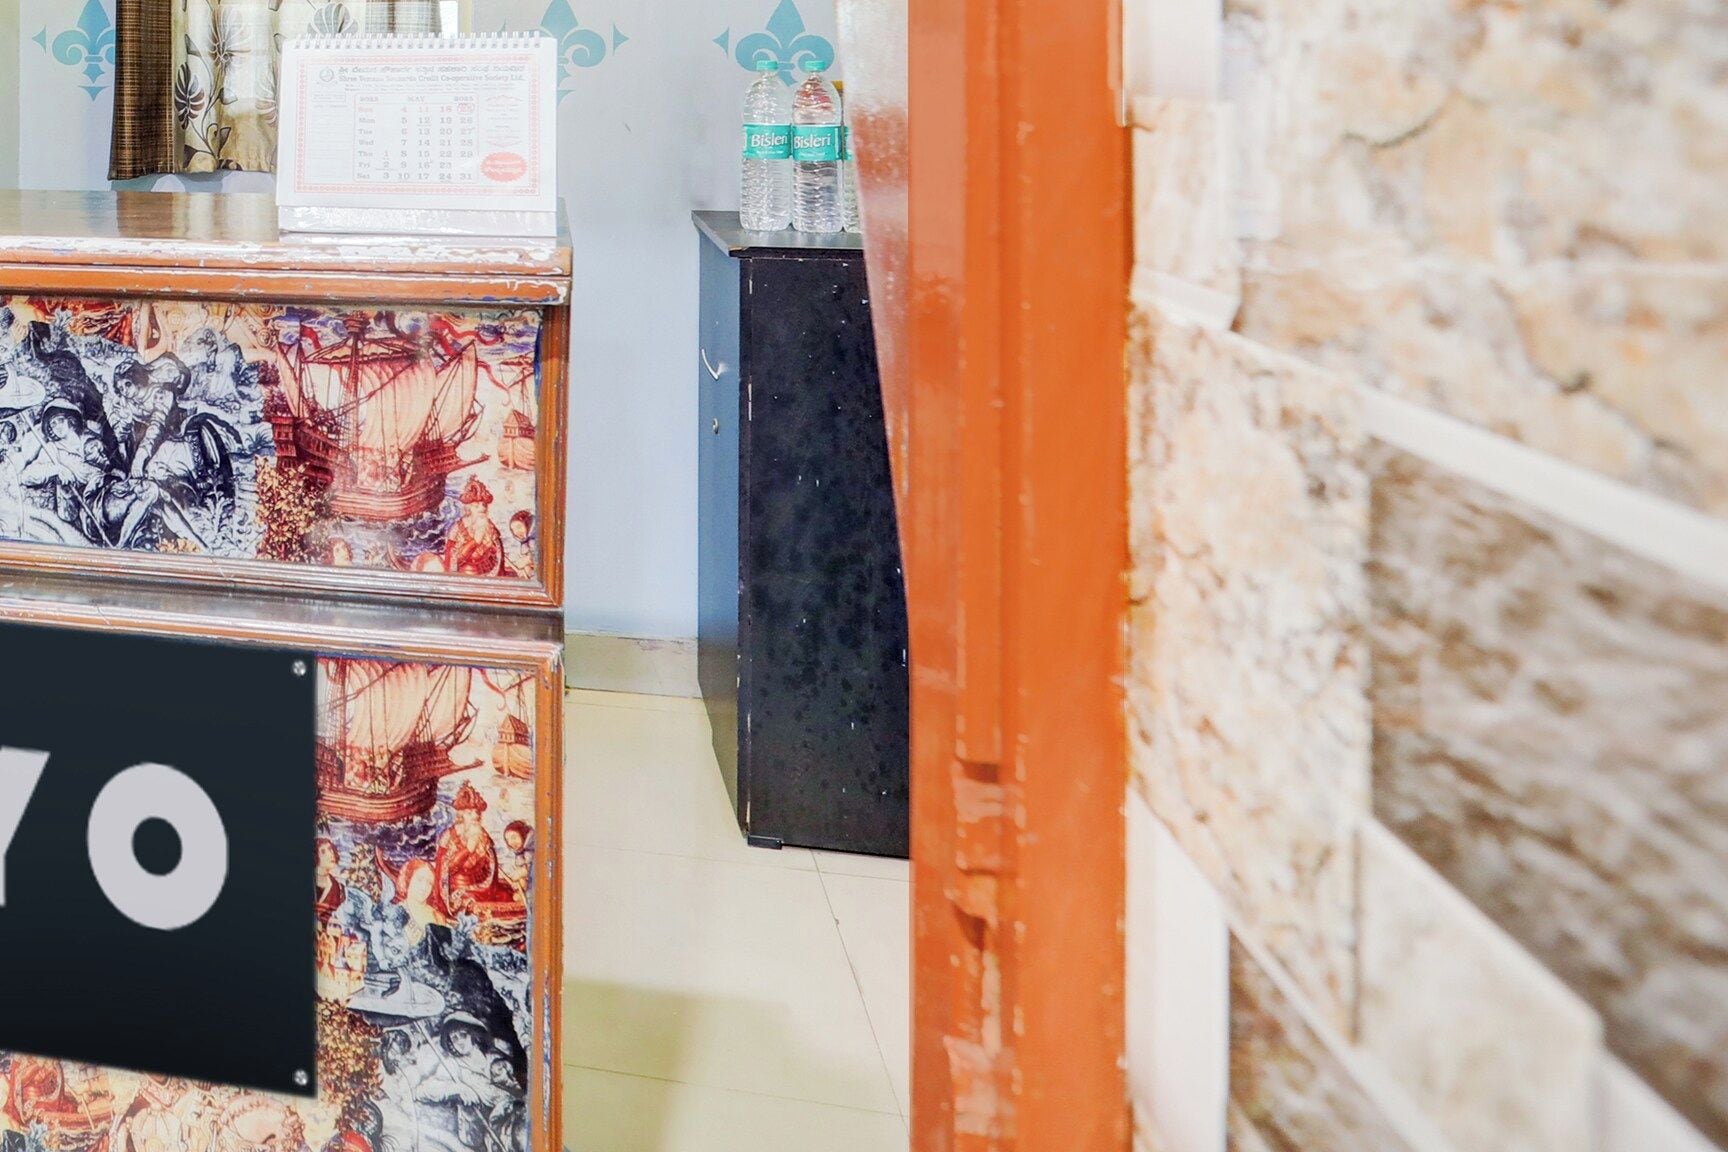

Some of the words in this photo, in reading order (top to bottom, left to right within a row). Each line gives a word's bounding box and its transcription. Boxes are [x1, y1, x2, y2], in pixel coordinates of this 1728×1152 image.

[485, 74, 509, 82] Society
[752, 132, 788, 147] Bisleri
[794, 134, 831, 149] Bisleri
